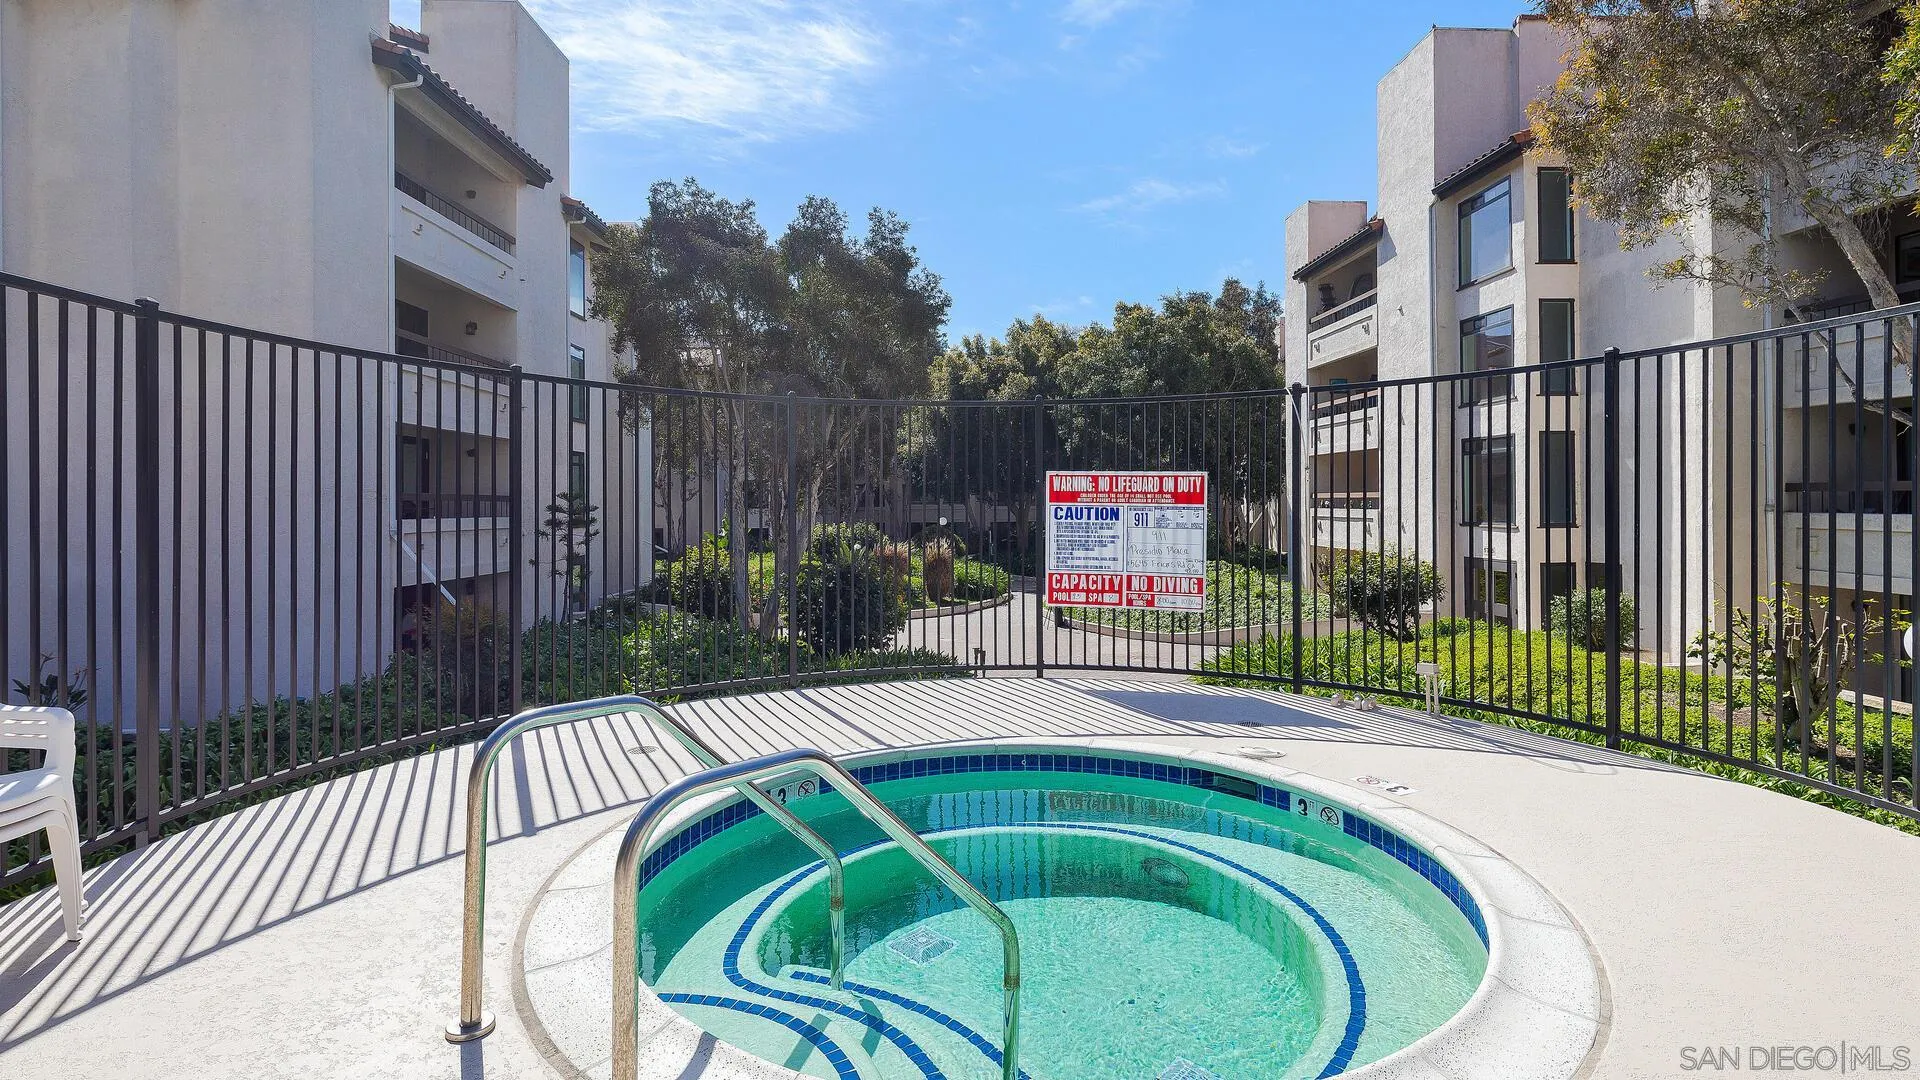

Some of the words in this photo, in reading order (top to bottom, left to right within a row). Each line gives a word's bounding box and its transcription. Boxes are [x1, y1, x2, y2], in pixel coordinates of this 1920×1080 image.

[1053, 476, 1095, 492] WARNING:
[1098, 476, 1110, 492] NO
[1112, 476, 1160, 492] LIFEGUARD
[1163, 476, 1175, 493] ON
[1177, 476, 1202, 493] DUTY
[1054, 507, 1120, 521] CAUTION
[1134, 512, 1149, 527] 911
[1052, 574, 1121, 591] CAPACITY
[1131, 575, 1148, 591] NO
[1153, 576, 1198, 594] DIVING
[1053, 591, 1071, 602] POOL
[1088, 592, 1103, 603] SPA
[1128, 593, 1152, 601] POOL/SPA
[1297, 798, 1308, 817] 3
